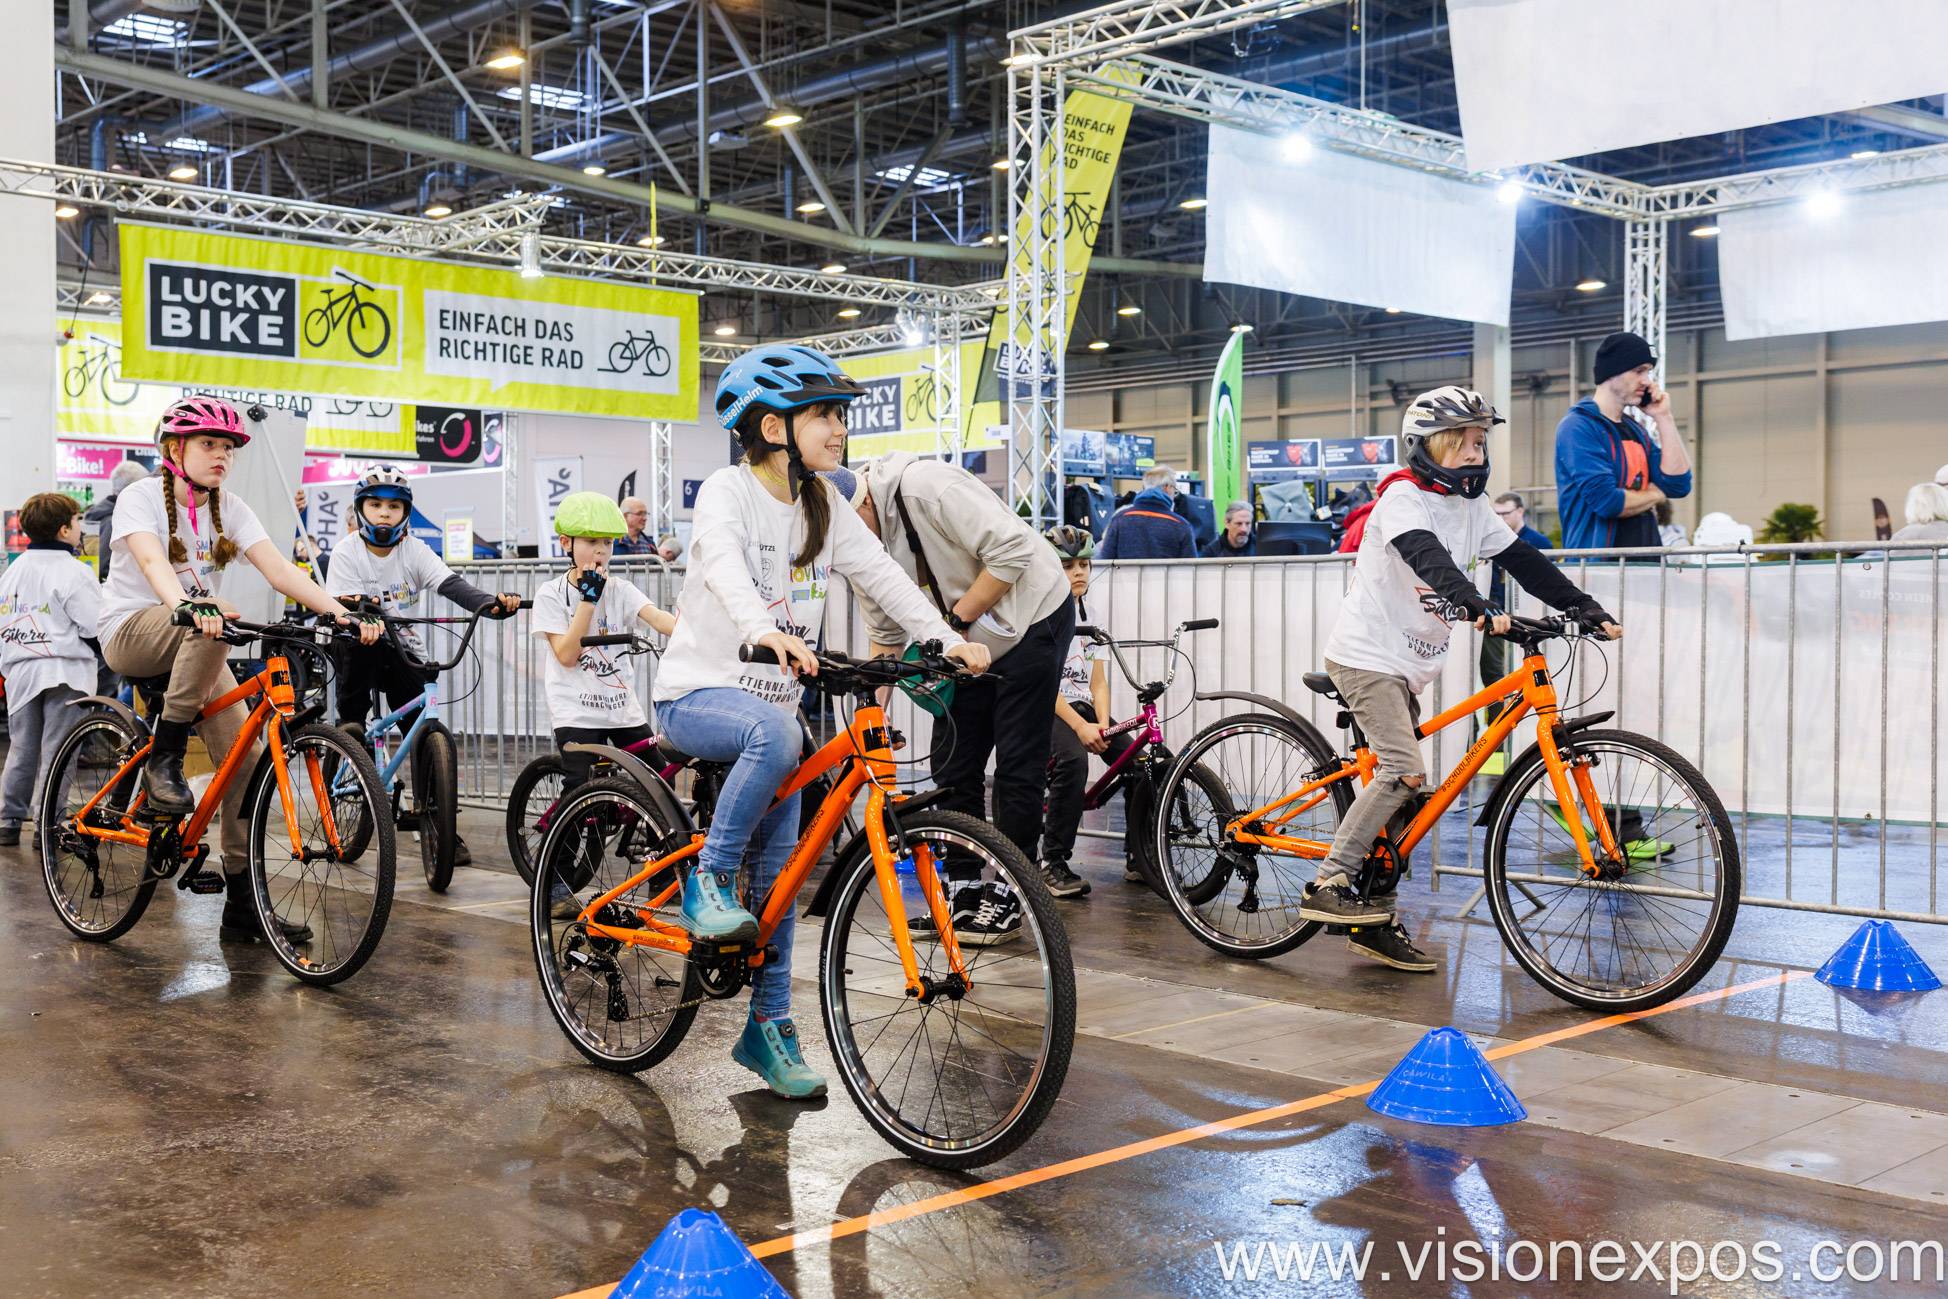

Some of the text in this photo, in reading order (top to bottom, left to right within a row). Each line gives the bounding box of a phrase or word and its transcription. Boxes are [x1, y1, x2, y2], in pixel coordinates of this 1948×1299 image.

[1064, 114, 1115, 135] EINFACH
[1064, 144, 1111, 163] ICHTIGE
[161, 275, 286, 312] LUCKY
[161, 304, 284, 347] BIKE
[439, 309, 574, 342] EINFACH DAS
[439, 337, 583, 369] RICHTIGE RAD
[684, 481, 693, 495] 6
[1442, 736, 1488, 793] #SCHOOLBIKERS
